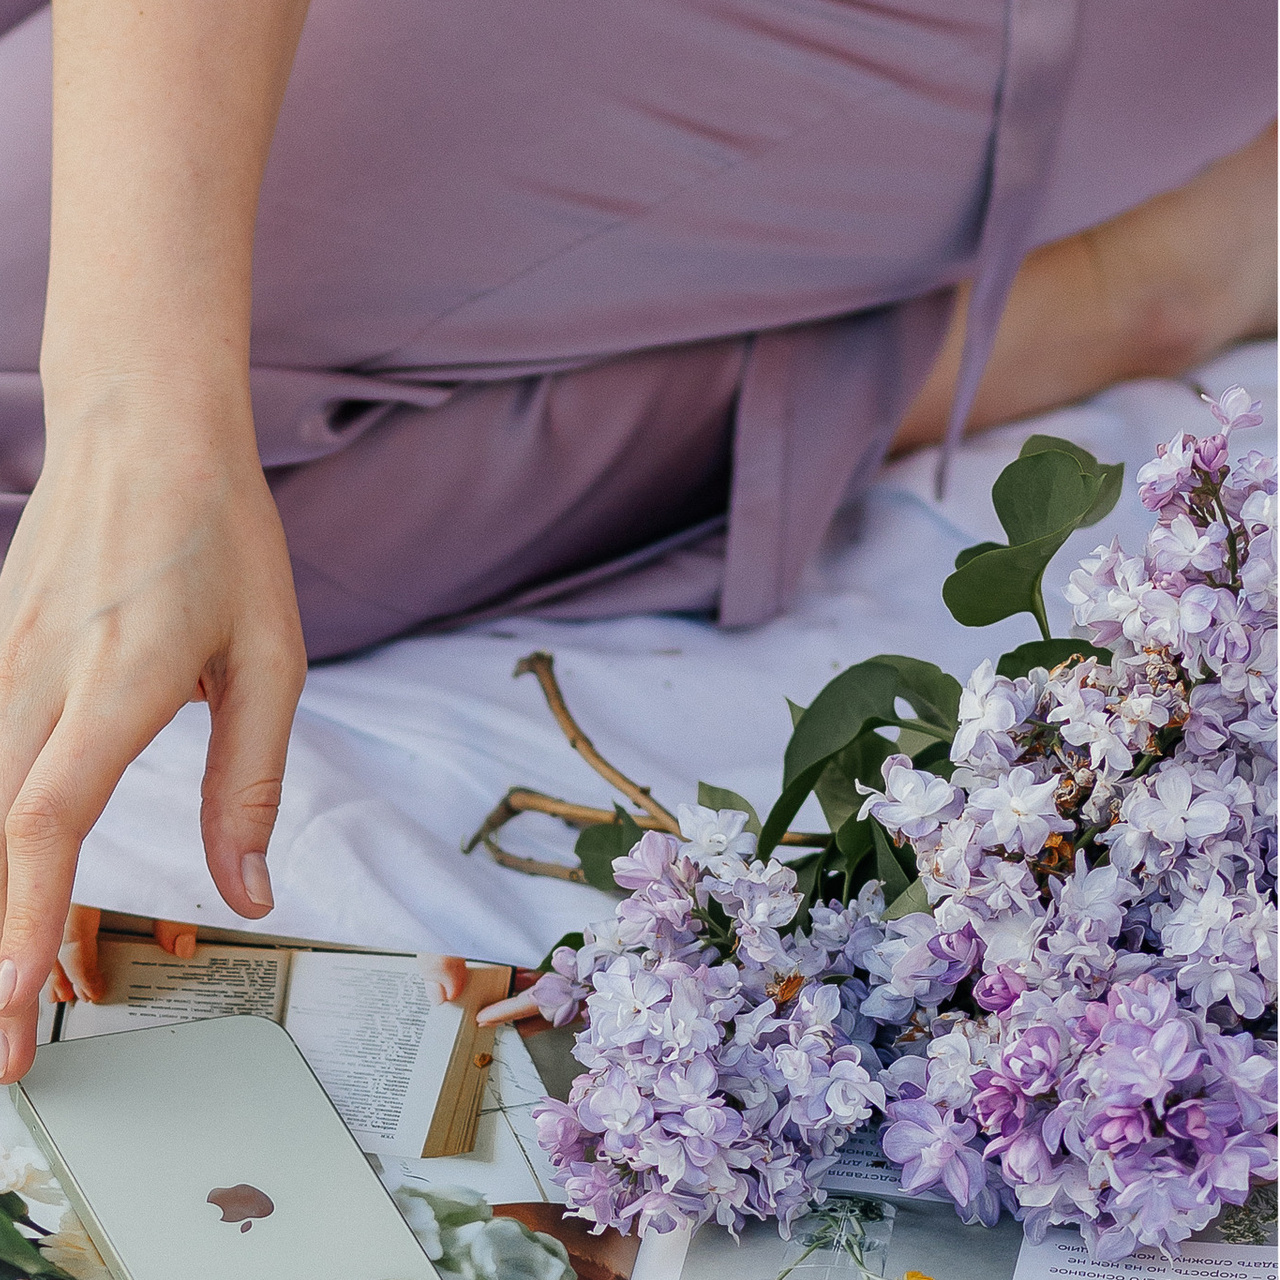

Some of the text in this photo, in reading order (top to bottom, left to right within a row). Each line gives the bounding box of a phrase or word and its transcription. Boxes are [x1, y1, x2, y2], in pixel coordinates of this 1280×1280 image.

[1091, 1260, 1119, 1268] нем
[1049, 1267, 1125, 1280] основное
[1146, 1266, 1166, 1274] но
